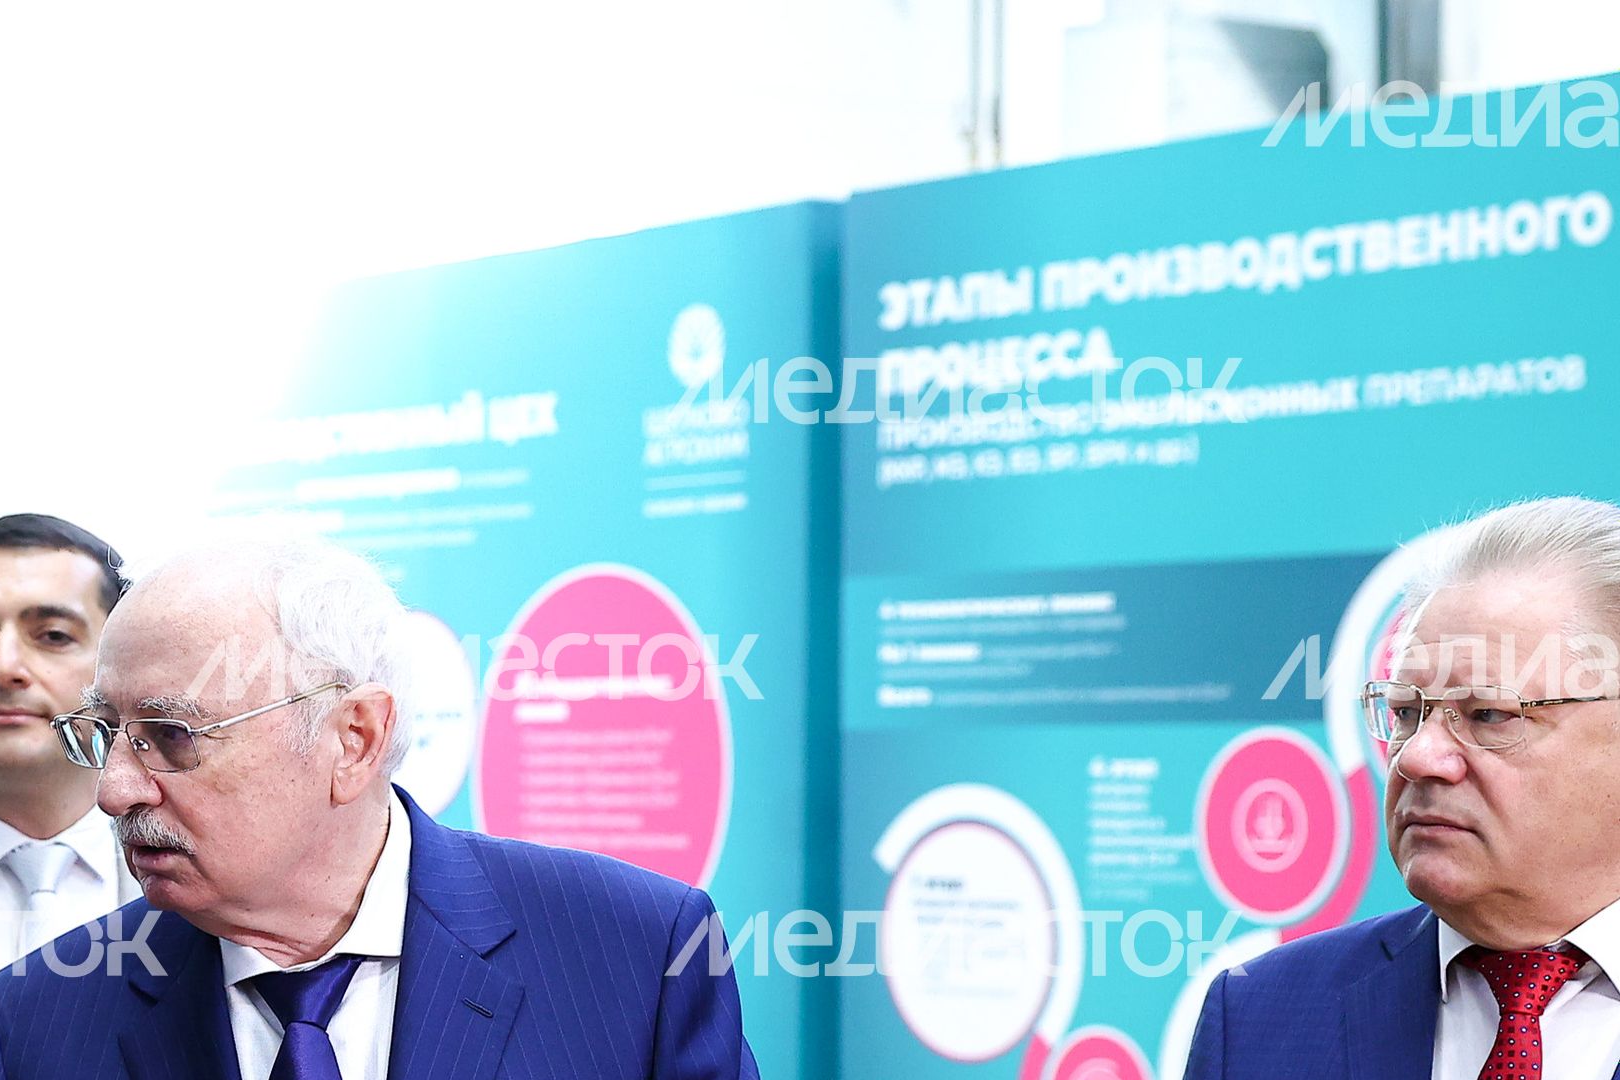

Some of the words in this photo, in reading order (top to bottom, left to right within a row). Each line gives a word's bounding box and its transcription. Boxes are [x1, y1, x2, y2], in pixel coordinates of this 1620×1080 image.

[878, 265, 1034, 330] ЭТАПЫ
[1041, 191, 1613, 308] ПРОИЗВОДСТВЕННОГО
[877, 328, 1114, 398] ПРОЦЕССА
